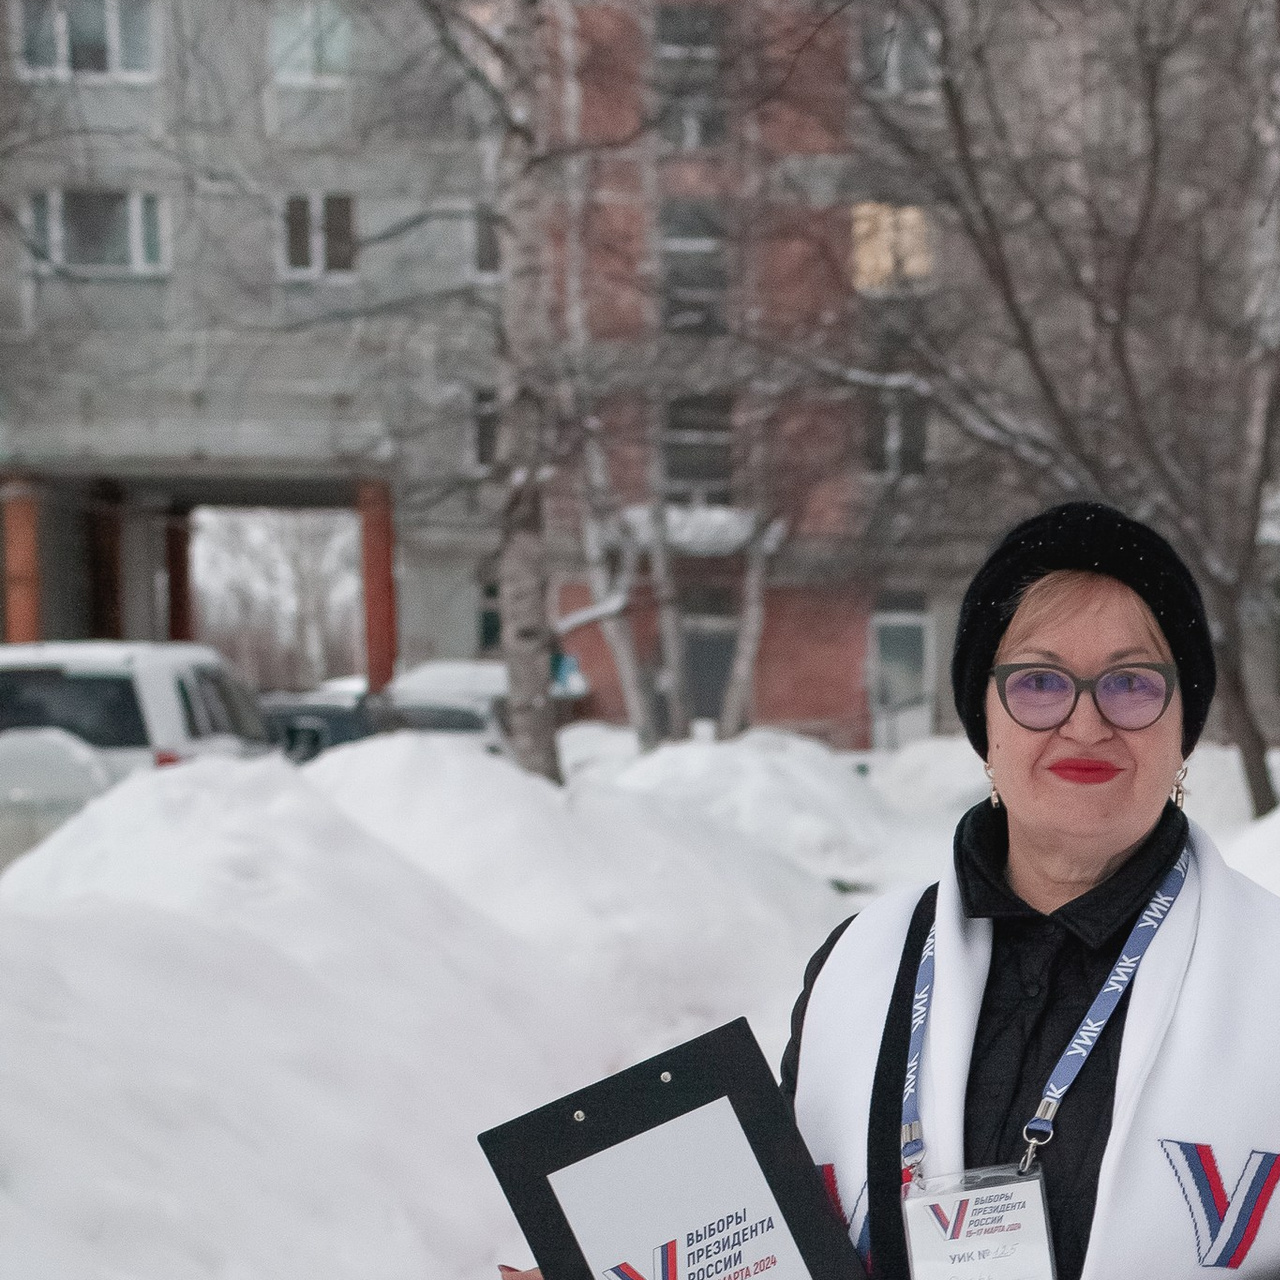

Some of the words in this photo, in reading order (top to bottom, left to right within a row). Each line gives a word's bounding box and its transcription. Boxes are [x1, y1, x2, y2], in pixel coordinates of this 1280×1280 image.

[1137, 890, 1175, 928] УИК
[1103, 954, 1141, 993] УИК
[911, 984, 930, 1034] УИК
[1066, 1017, 1106, 1057] УИК
[903, 1052, 920, 1102] УИК
[971, 1201, 1026, 1217] ПРЕЗИДЕНТА
[974, 1192, 1014, 1206] ВЫБОРЫ
[686, 1208, 747, 1248] ВЫБОРЫ
[968, 1215, 1004, 1228] РОССИИ
[687, 1216, 775, 1268] ПРЕЗИДЕНТА
[949, 1251, 975, 1265] УИК
[753, 1254, 778, 1276] 2024
